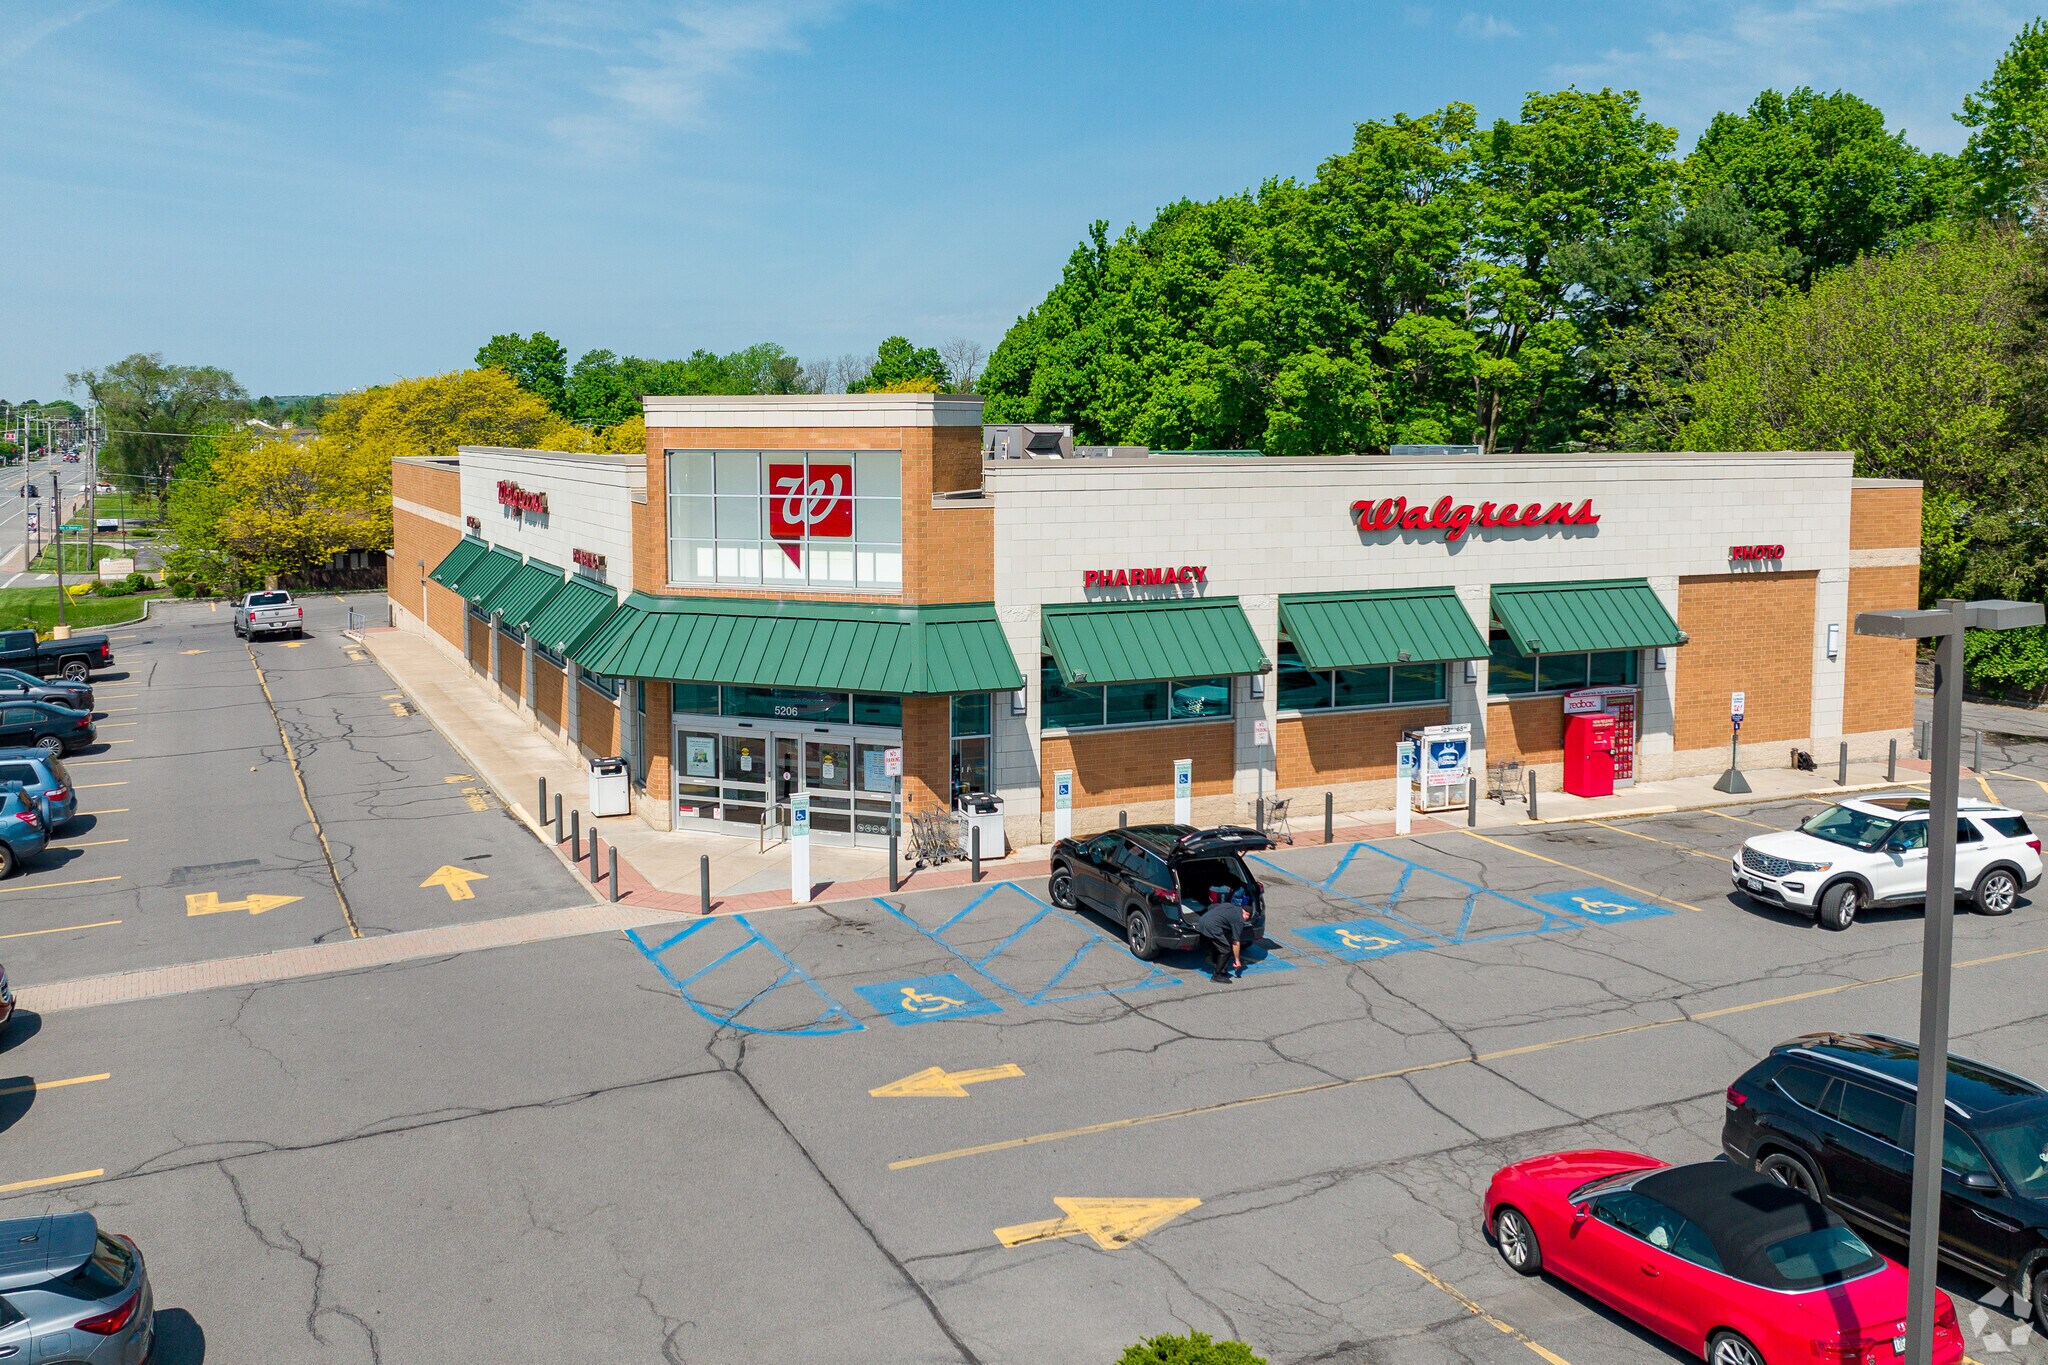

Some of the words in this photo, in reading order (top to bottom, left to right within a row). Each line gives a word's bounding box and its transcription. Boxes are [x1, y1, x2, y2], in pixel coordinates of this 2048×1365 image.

[1351, 495, 1601, 541] Walgreens
[1729, 544, 1785, 561] PHOTO
[1083, 566, 1207, 588] PHARMACY
[774, 705, 798, 716] 5206
